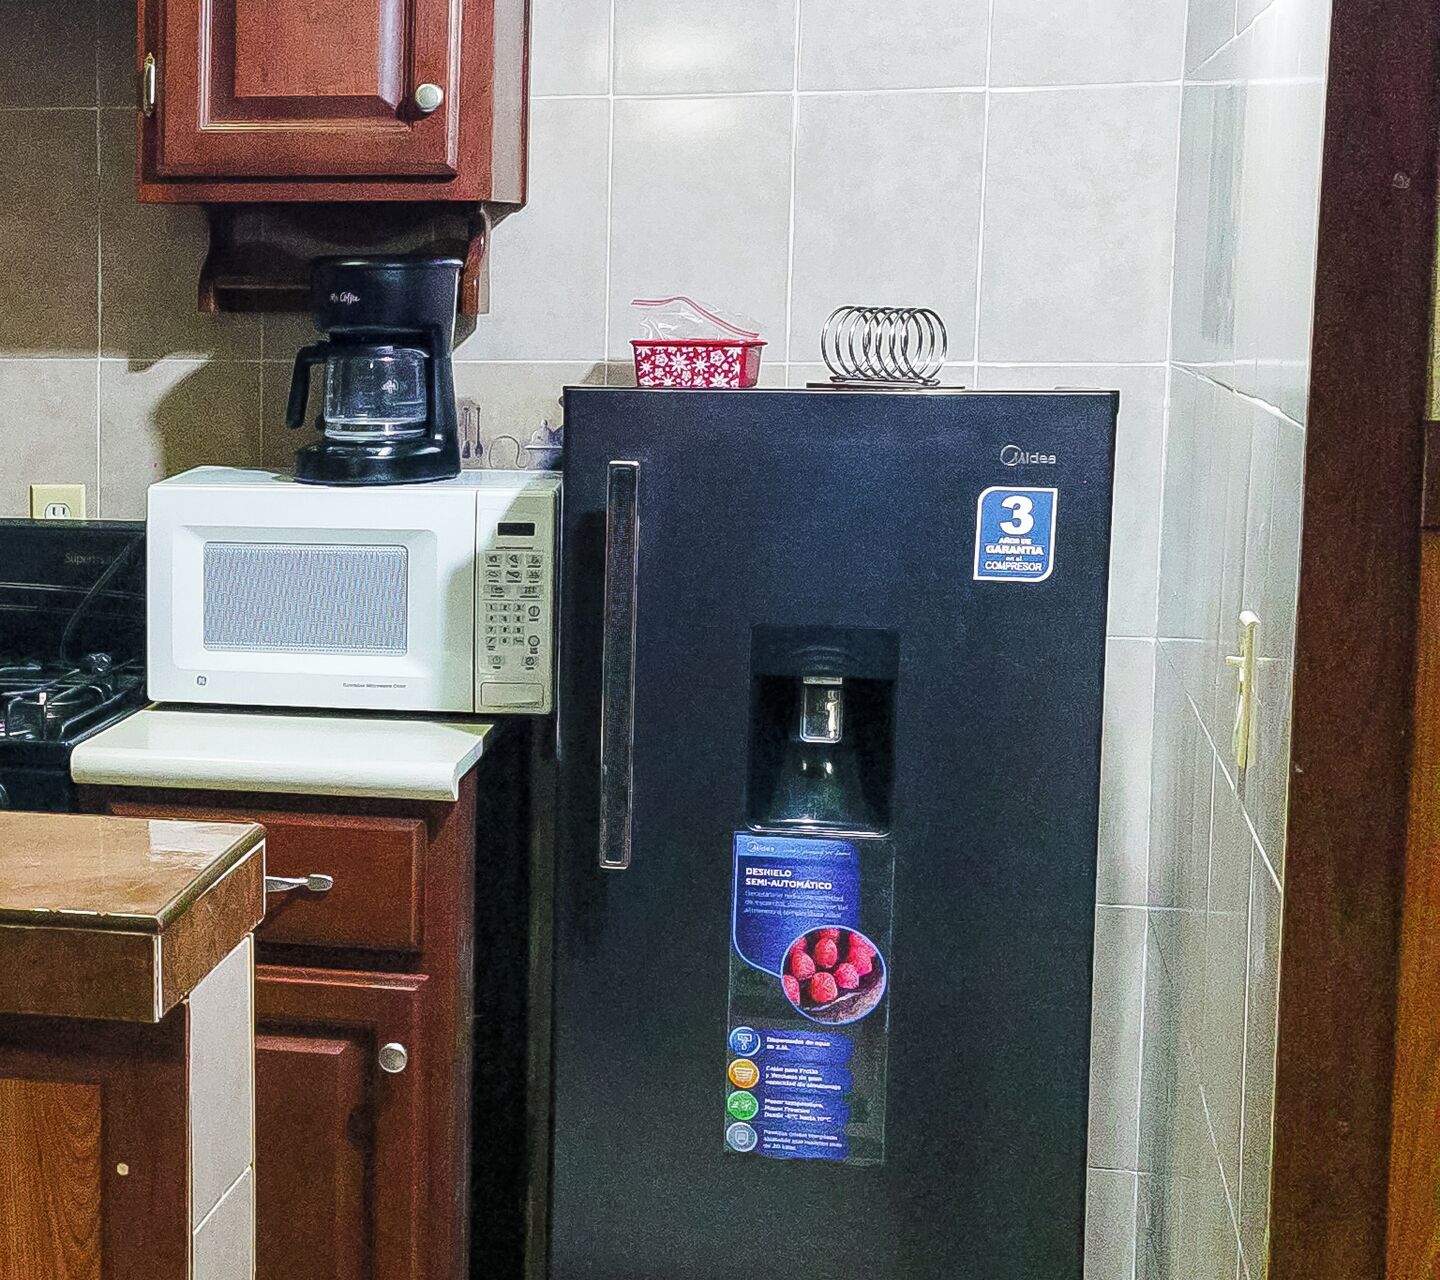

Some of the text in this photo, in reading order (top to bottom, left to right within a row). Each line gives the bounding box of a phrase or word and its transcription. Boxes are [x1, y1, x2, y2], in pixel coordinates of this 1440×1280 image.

[1000, 444, 1057, 466] Midea
[999, 495, 1035, 535] 3
[985, 561, 1042, 571] COMPRESOR
[745, 867, 792, 877] DESHIELO
[745, 878, 833, 890] SEMI-AUTOMÁTICO
